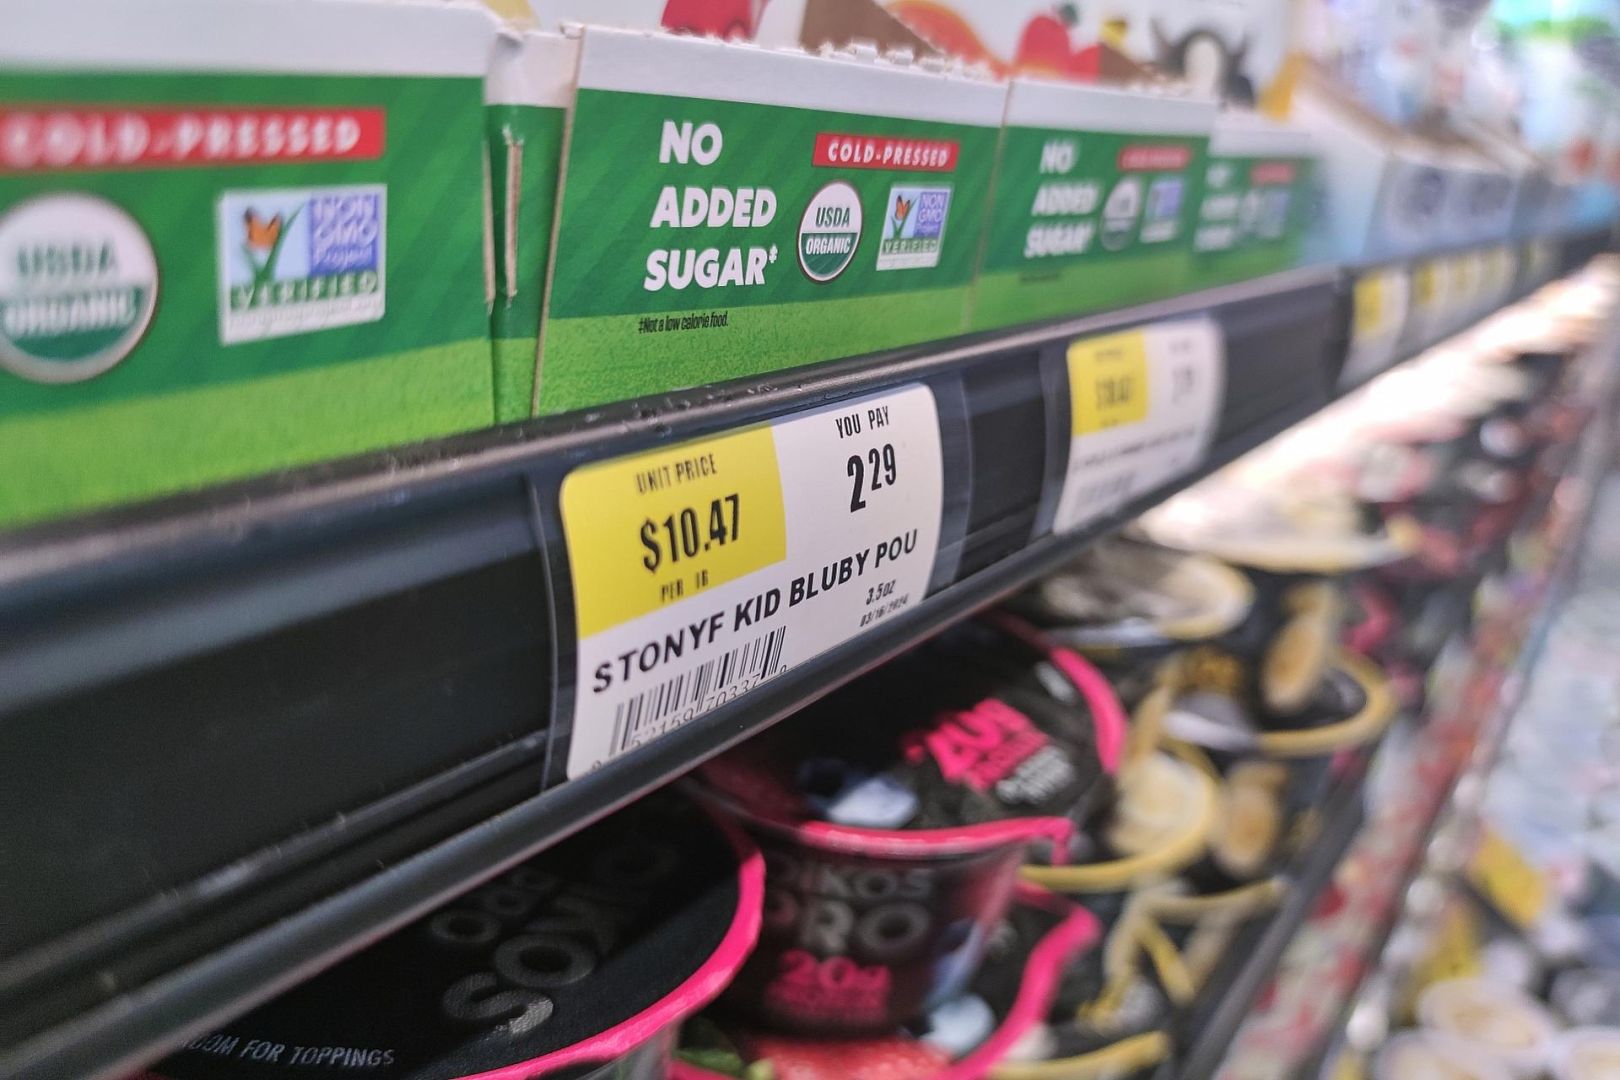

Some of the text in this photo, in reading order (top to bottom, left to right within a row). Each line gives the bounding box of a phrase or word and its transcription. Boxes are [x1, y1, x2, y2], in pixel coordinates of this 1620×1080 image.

[659, 120, 722, 166] NO
[827, 140, 948, 168] COLD-PRESSED
[650, 187, 777, 228] ADDED
[920, 194, 945, 207] NON
[816, 206, 851, 228] USDA
[917, 208, 943, 223] GMO
[805, 236, 852, 256] ORGANIC
[884, 239, 938, 254] VERIFIED
[681, 312, 709, 330] calorie
[836, 405, 890, 439] YOU PAY
[636, 453, 718, 495] UNIT PRICE
[640, 493, 740, 574] $10.47
[661, 579, 684, 602] PER
[593, 528, 918, 694] STONYF KID BLUBY POU
[240, 1039, 285, 1062] FOR
[290, 1045, 395, 1068] TOPPINGS
